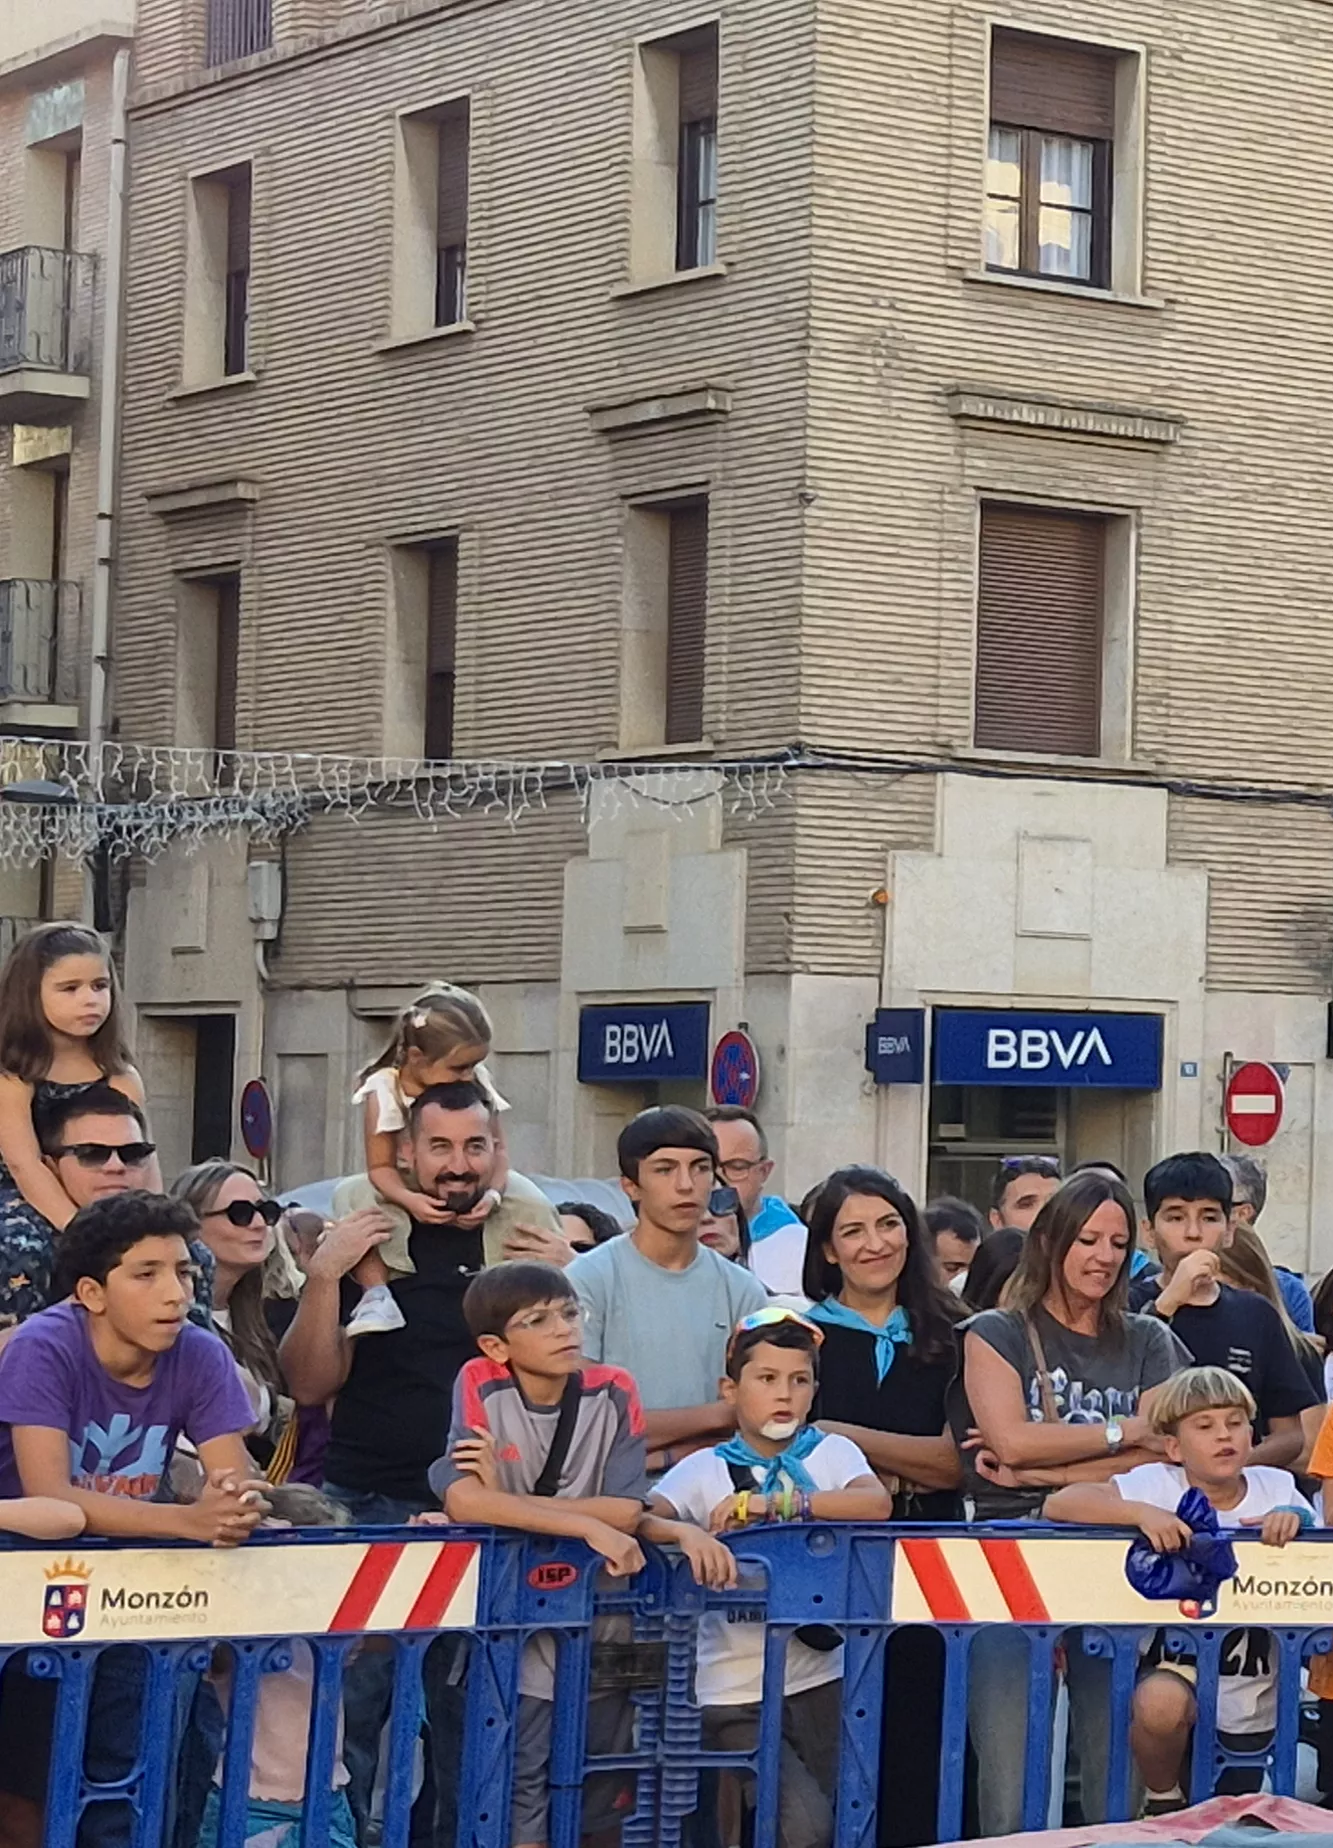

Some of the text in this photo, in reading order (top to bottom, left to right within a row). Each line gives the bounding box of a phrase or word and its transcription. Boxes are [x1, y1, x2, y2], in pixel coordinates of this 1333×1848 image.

[604, 1018, 674, 1064] BBVA
[877, 1036, 911, 1055] BBVA
[986, 1026, 1112, 1070] BBVA
[100, 1584, 209, 1610] Monzón
[100, 1613, 208, 1628] Ayuntamiento
